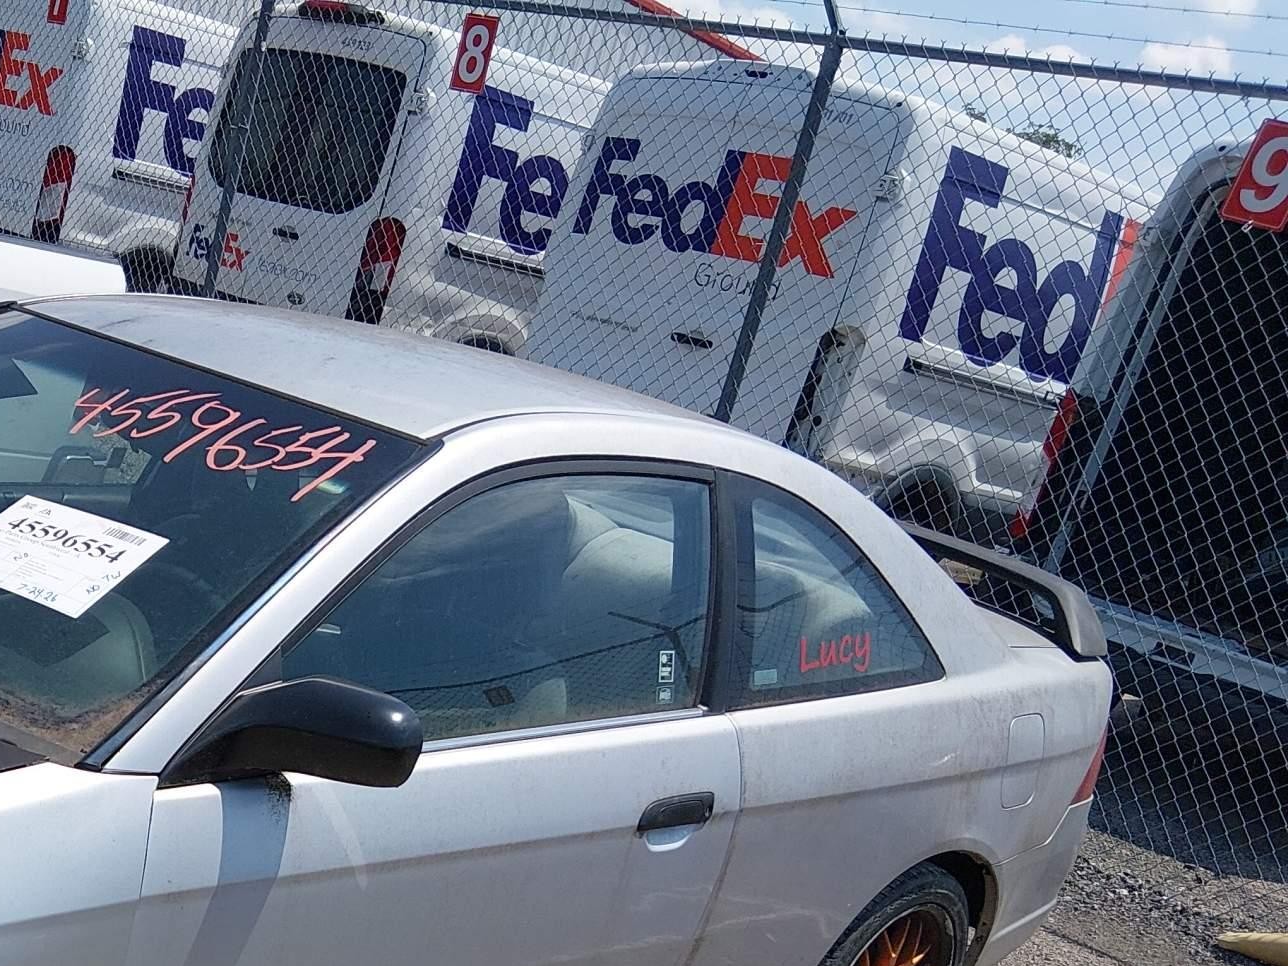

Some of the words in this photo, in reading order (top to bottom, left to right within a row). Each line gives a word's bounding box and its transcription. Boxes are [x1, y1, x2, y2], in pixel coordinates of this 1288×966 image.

[113, 25, 215, 177] Fe
[458, 24, 489, 84] 8
[442, 84, 569, 255] Fe
[571, 136, 857, 279] FedEx
[1239, 136, 1288, 214] 9
[187, 224, 250, 272] FeEx
[898, 145, 1142, 384] Fed
[69, 388, 378, 502] 45596554
[8, 517, 127, 563] 45596554
[799, 632, 871, 672] Lucy
